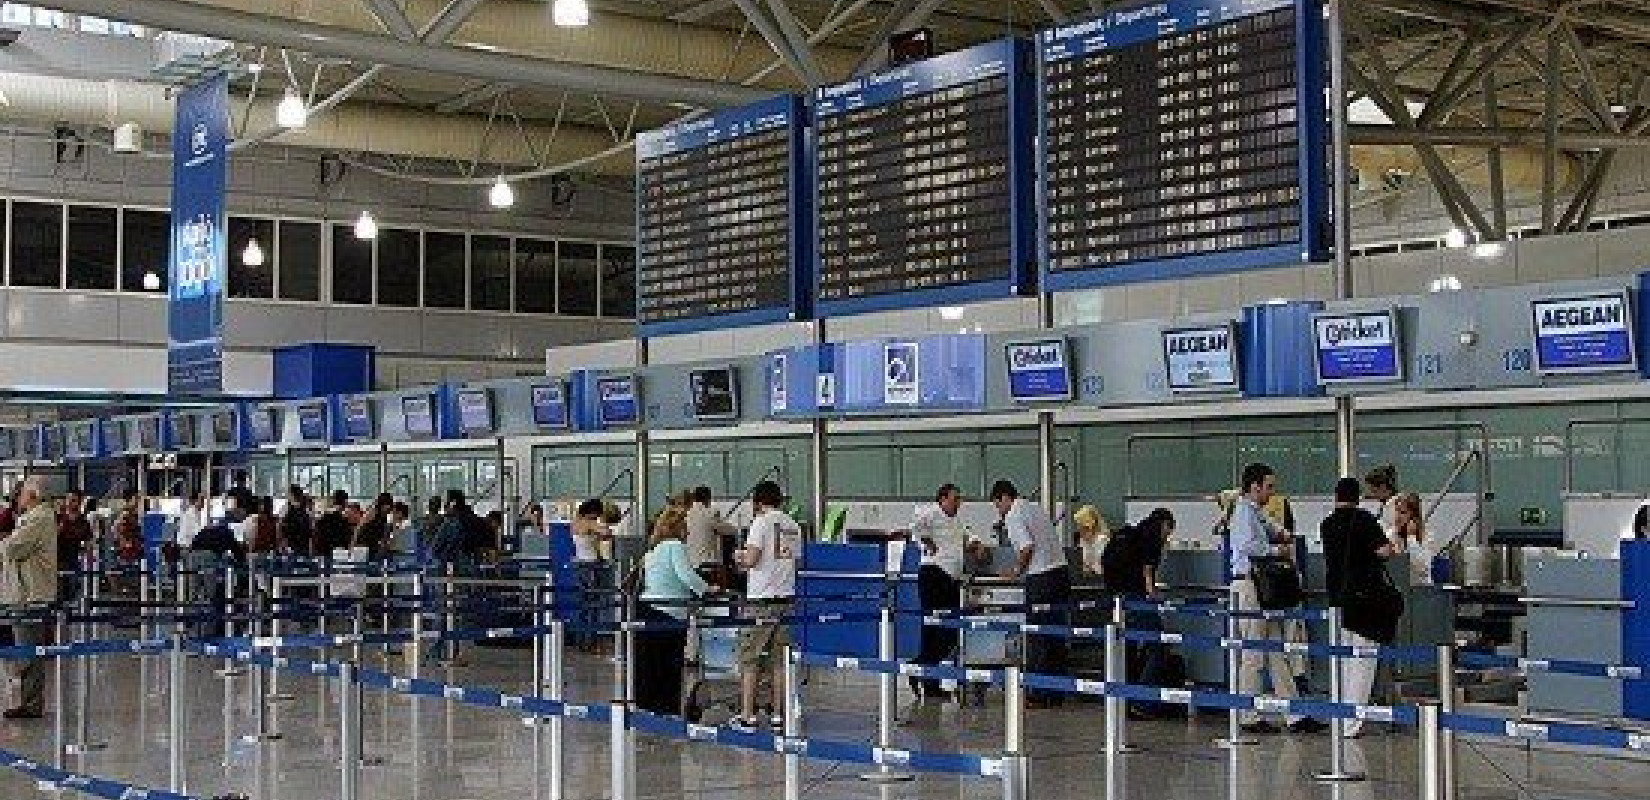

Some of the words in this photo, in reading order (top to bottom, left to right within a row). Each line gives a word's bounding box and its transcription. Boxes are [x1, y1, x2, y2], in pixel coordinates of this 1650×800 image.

[1541, 304, 1621, 328] AEGEAN
[1169, 333, 1229, 354] AEGEAN
[1502, 348, 1531, 371] 120
